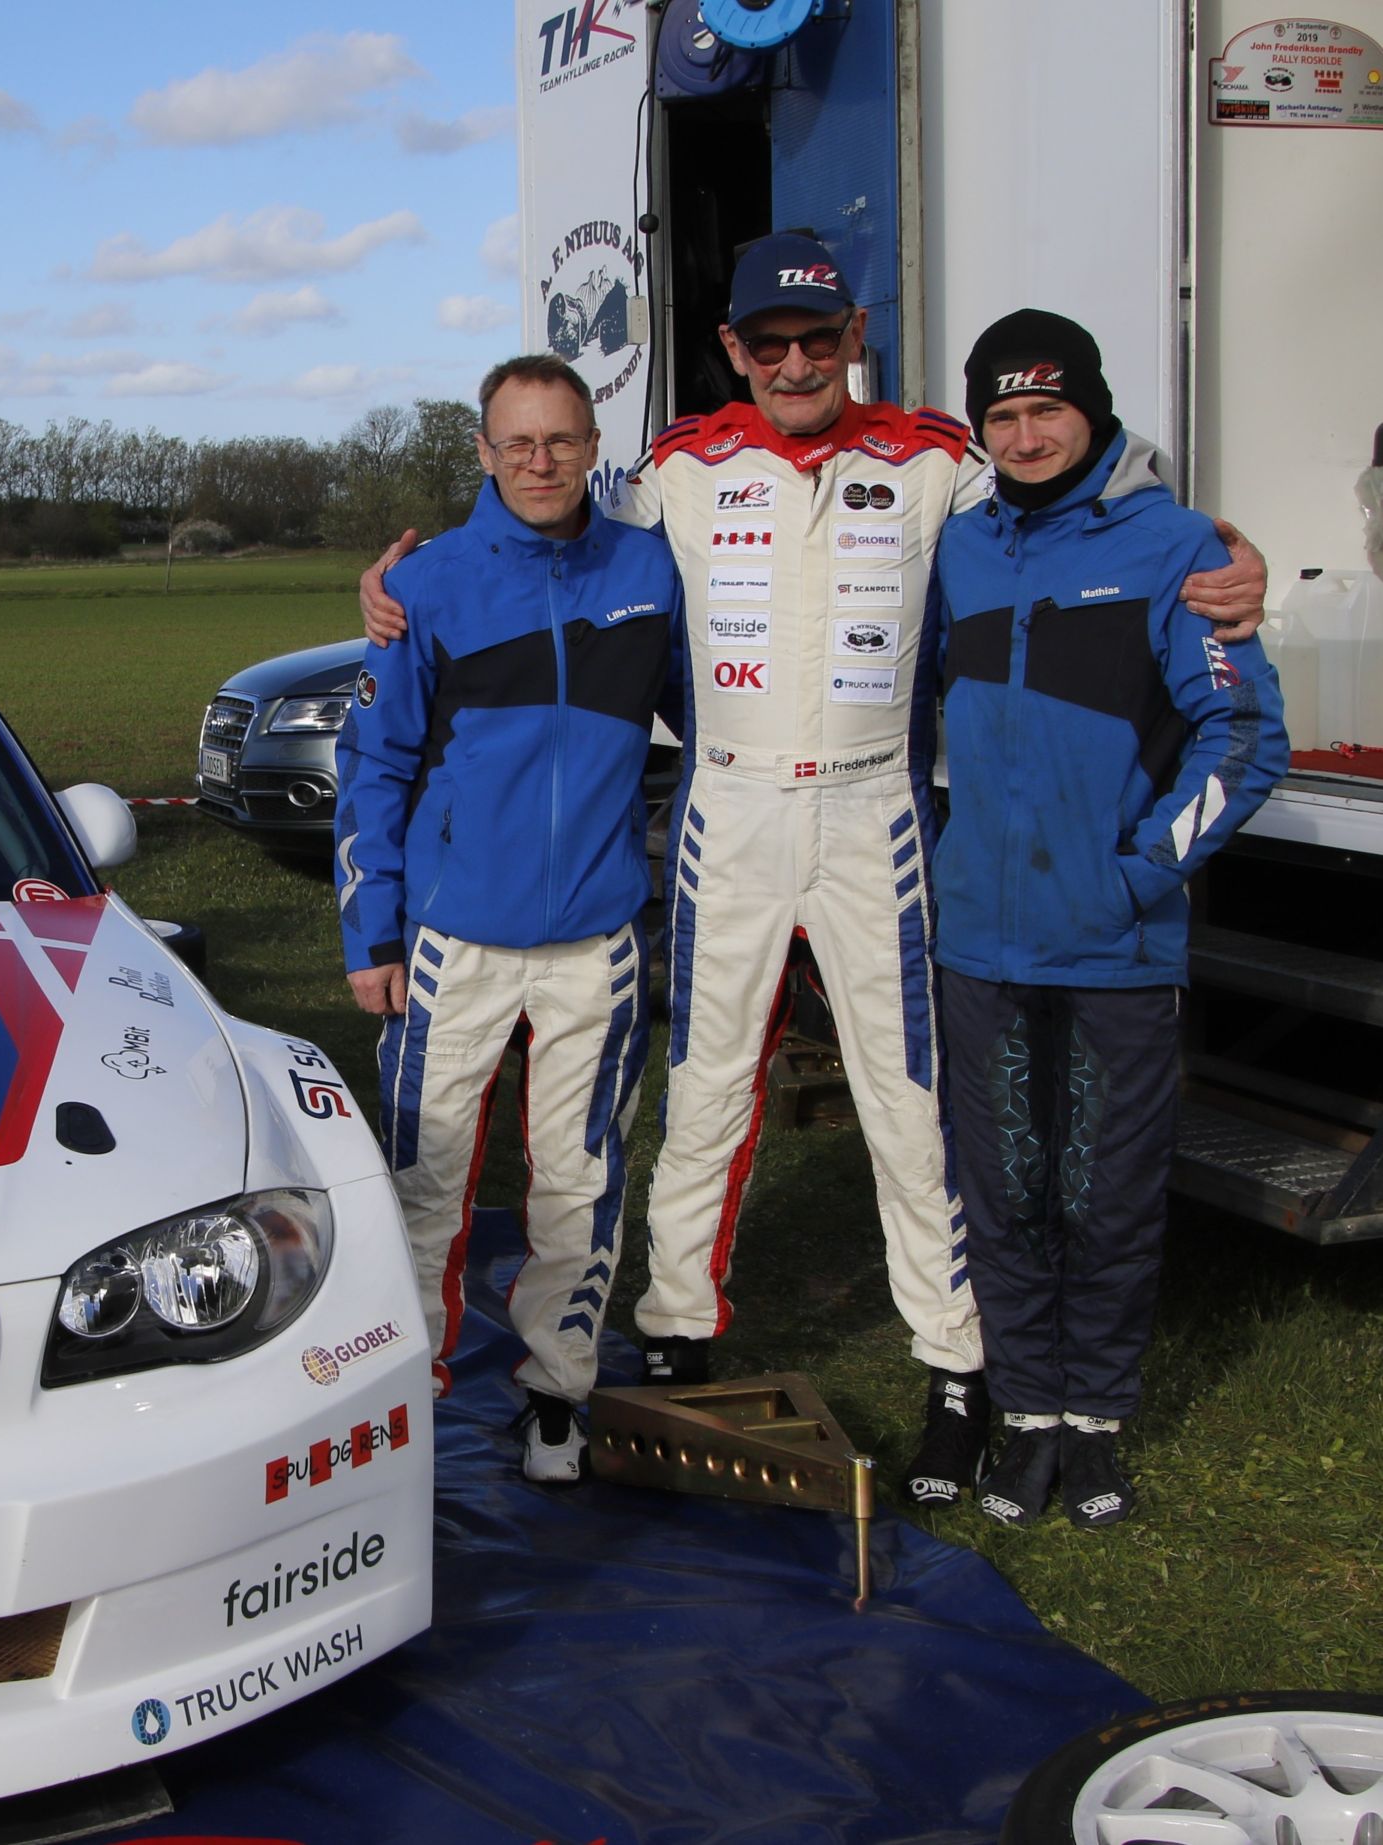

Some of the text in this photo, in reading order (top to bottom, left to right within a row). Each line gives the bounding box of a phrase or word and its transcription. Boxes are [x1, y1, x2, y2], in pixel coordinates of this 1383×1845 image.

[1296, 22, 1328, 31] September
[1297, 33, 1318, 42] 2019
[1250, 42, 1272, 51] John
[1275, 43, 1325, 53] Frederiksen
[1272, 54, 1342, 65] RALLY ROSKILDE
[539, 43, 635, 95] TEAM HYLLINGE RACING
[564, 220, 621, 259] NYHUUS
[858, 536, 896, 545] GLOBEX
[1080, 586, 1120, 599] Mathias
[627, 603, 655, 613] Larsen
[709, 618, 767, 633] fairside
[714, 661, 766, 688] OK
[844, 681, 870, 689] TRUCK
[334, 1321, 400, 1363] GLOBEX
[647, 1354, 664, 1362] OMP
[945, 1384, 966, 1395] OMP
[1010, 1414, 1027, 1422] OMP
[1087, 1416, 1107, 1425] OMP
[272, 1417, 405, 1491] SPUL OG RENS
[912, 1479, 959, 1496] OMP
[981, 1496, 1020, 1518] OMP
[1081, 1495, 1122, 1514] OMP
[223, 1531, 385, 1627] fairside
[175, 1624, 364, 1727] TRUCK WASH
